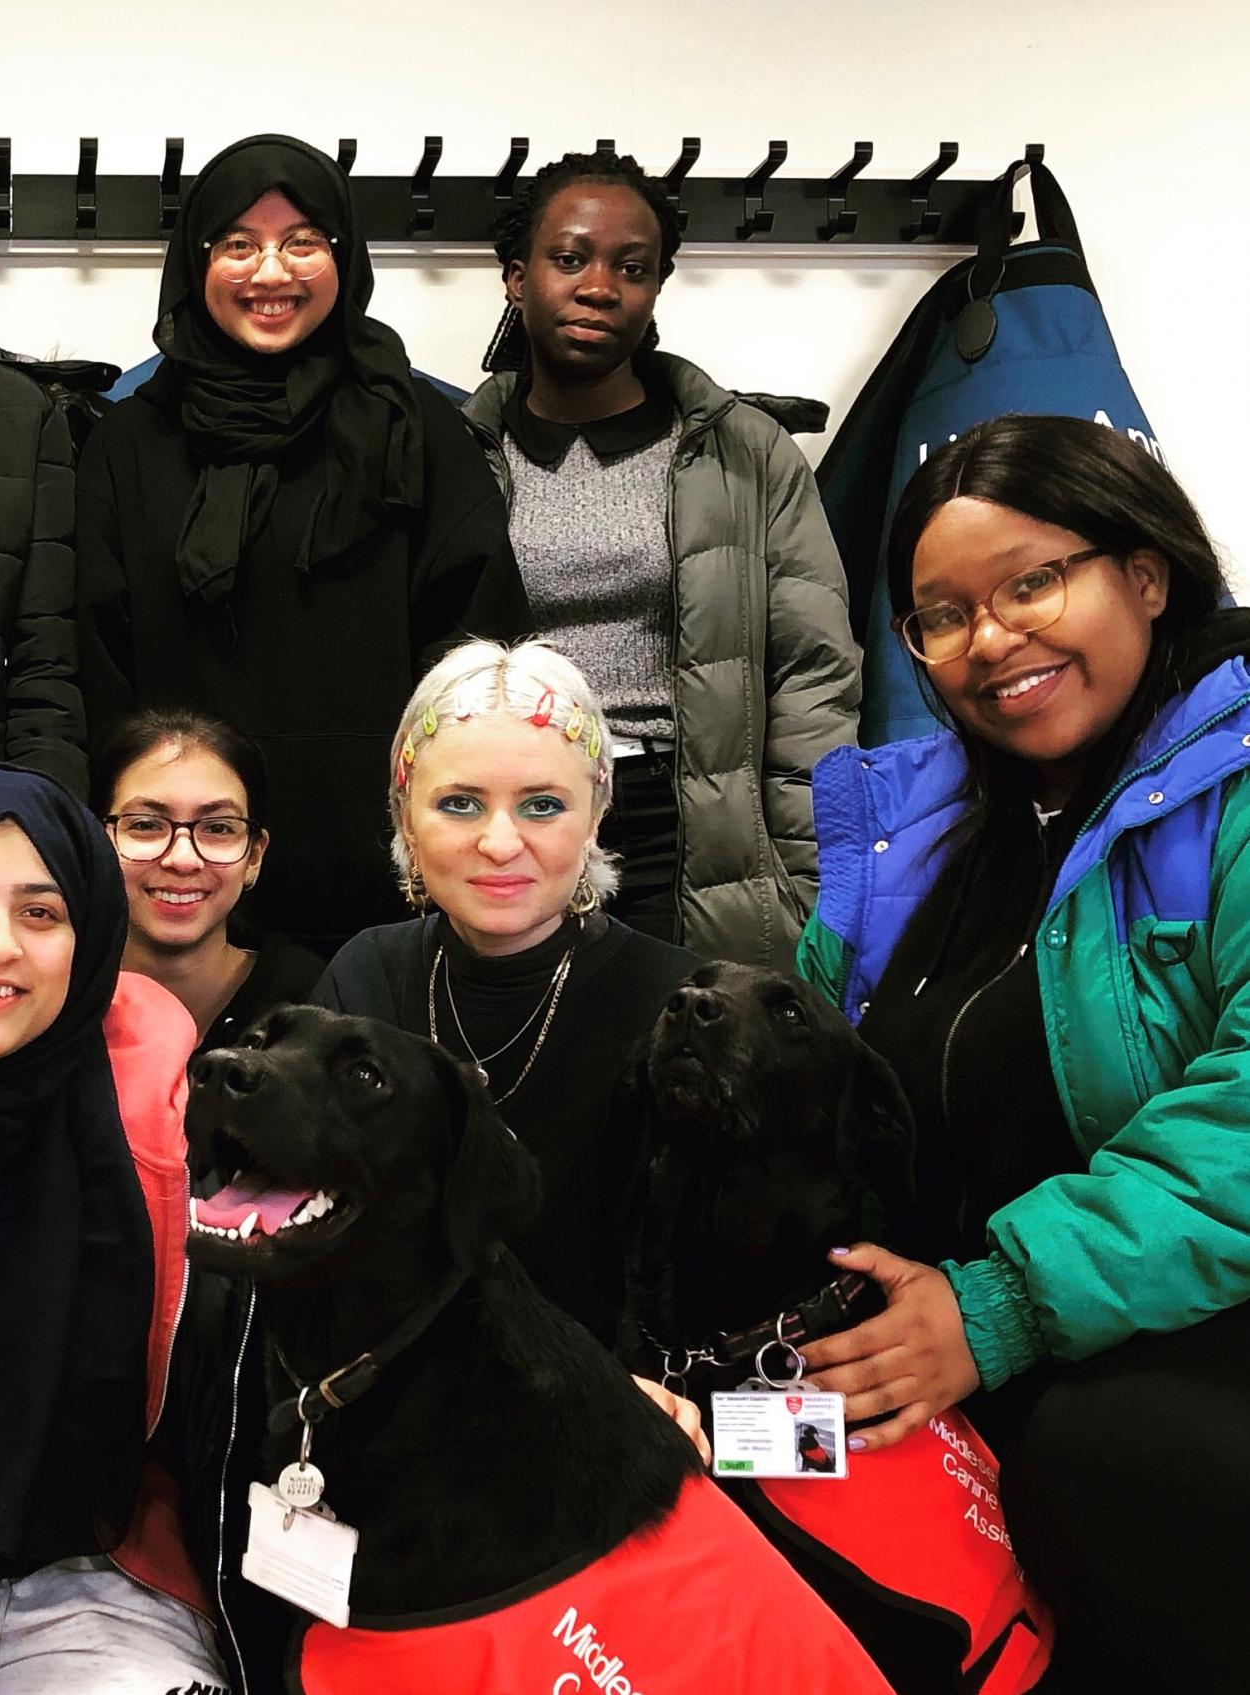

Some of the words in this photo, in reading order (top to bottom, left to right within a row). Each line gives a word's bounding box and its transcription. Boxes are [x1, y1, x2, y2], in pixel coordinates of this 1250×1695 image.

[943, 1453, 998, 1510] Canine
[964, 1503, 1013, 1551] Assis
[552, 1606, 643, 1695] Middle
